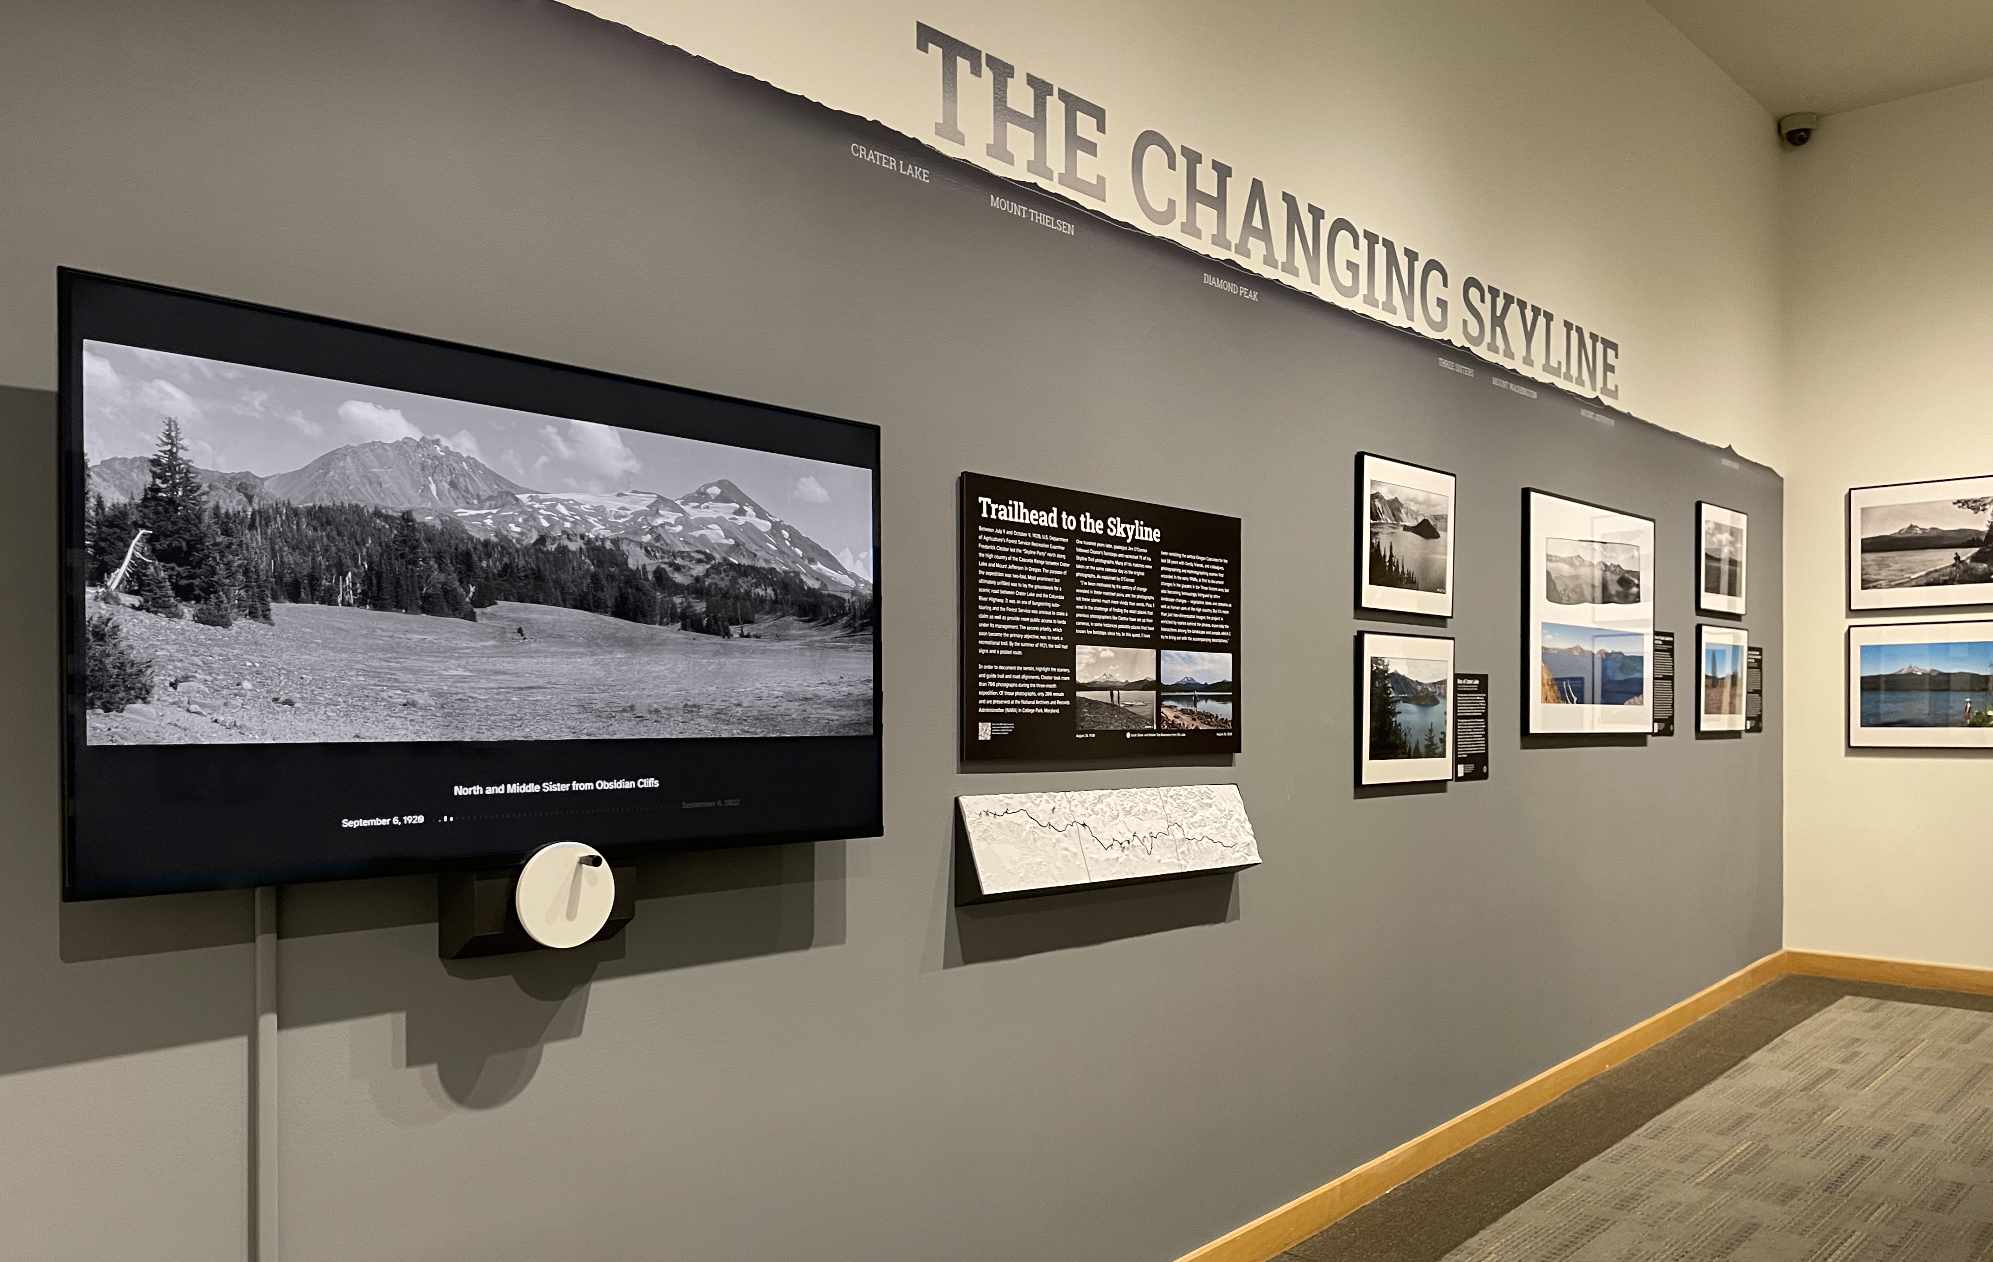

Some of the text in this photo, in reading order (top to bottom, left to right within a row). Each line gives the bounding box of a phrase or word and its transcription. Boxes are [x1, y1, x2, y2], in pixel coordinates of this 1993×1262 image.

[851, 143, 930, 183] CRATER LAKE
[917, 21, 1620, 400] THE CHANGING SKYLINE
[990, 194, 1075, 236] MOUNT THIELSEN
[1203, 273, 1259, 301] DIAMOND PEAK
[978, 496, 1161, 543] Trailhead to the Skyline
[453, 777, 660, 796] North and Middle Sister from Obsidian Cliffs
[341, 817, 391, 828] September
[392, 816, 402, 826] 6,
